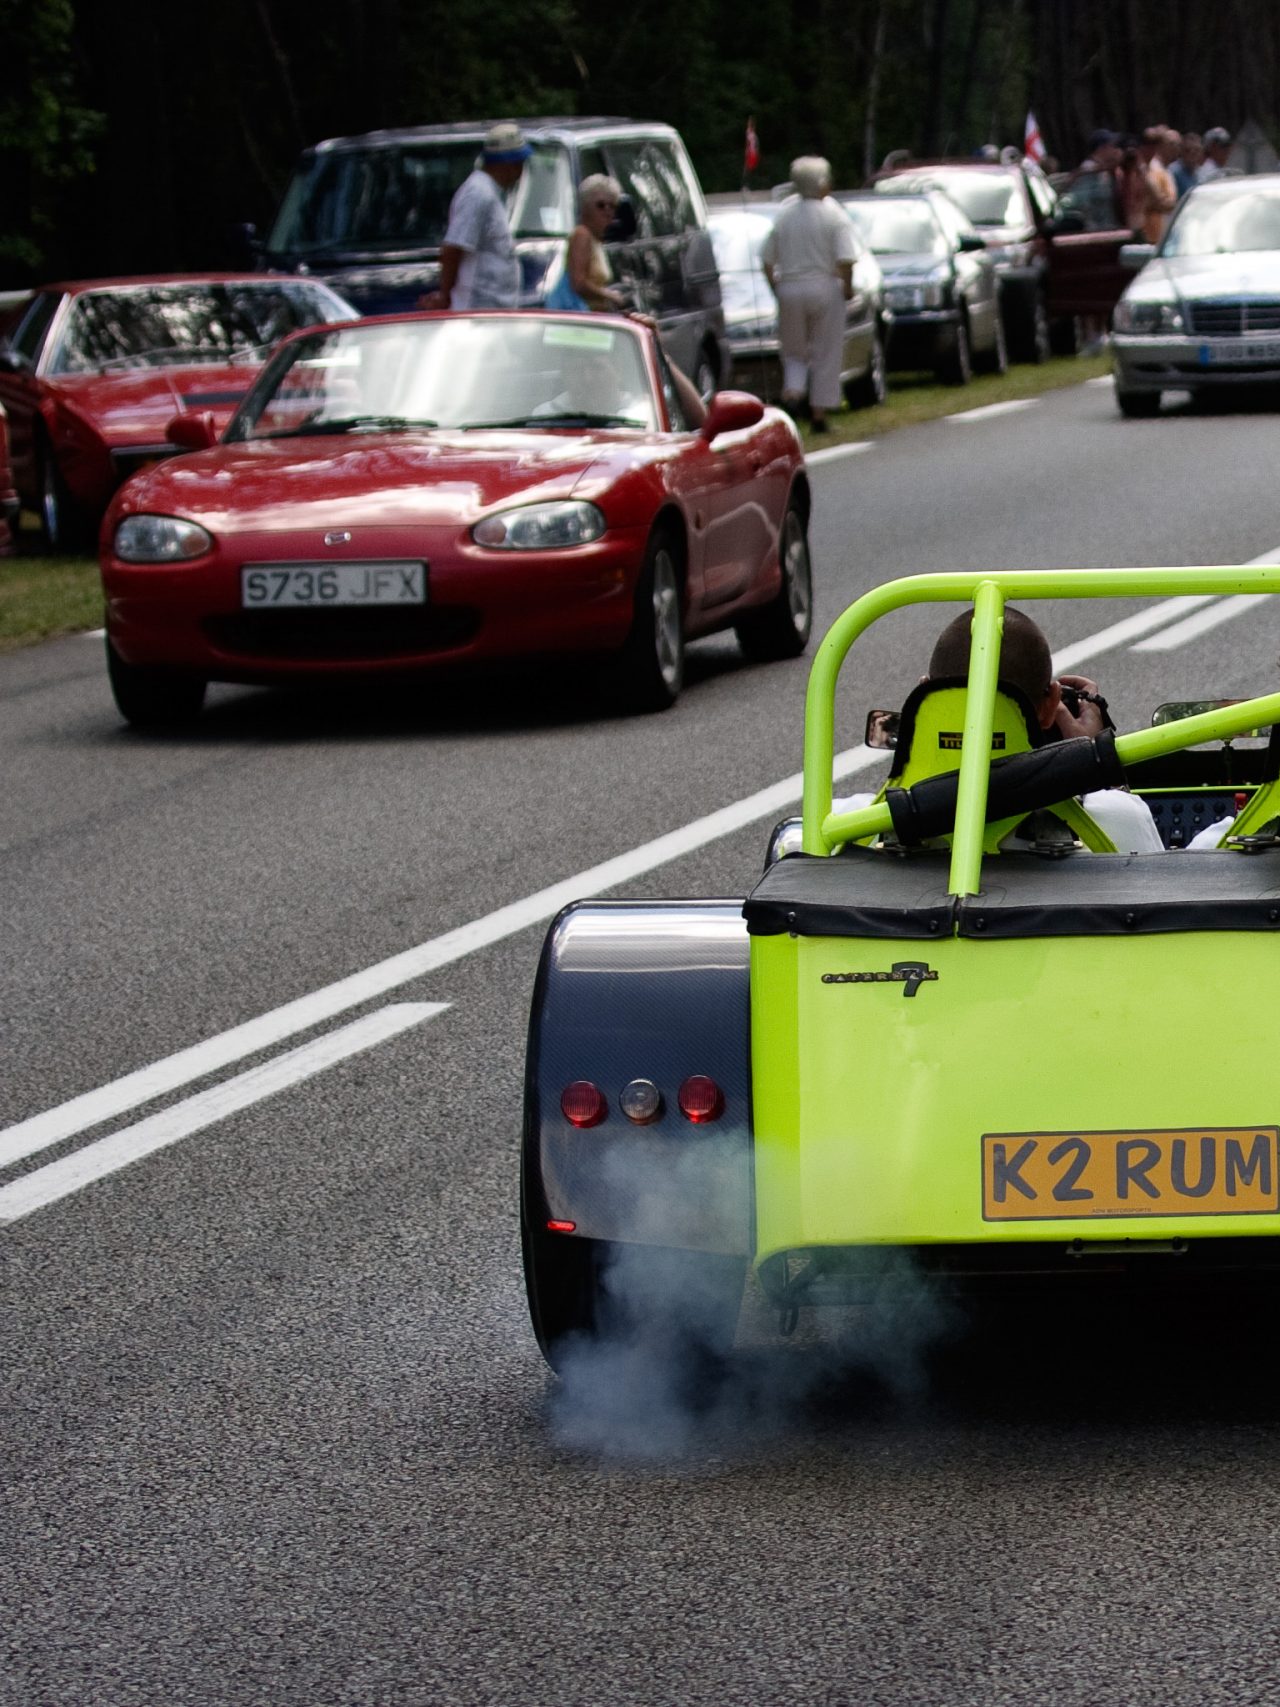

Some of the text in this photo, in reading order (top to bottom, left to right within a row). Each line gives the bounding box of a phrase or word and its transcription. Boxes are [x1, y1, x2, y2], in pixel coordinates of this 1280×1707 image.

[247, 568, 418, 601] S736 JFX
[993, 1134, 1271, 1203] K2 RUM
